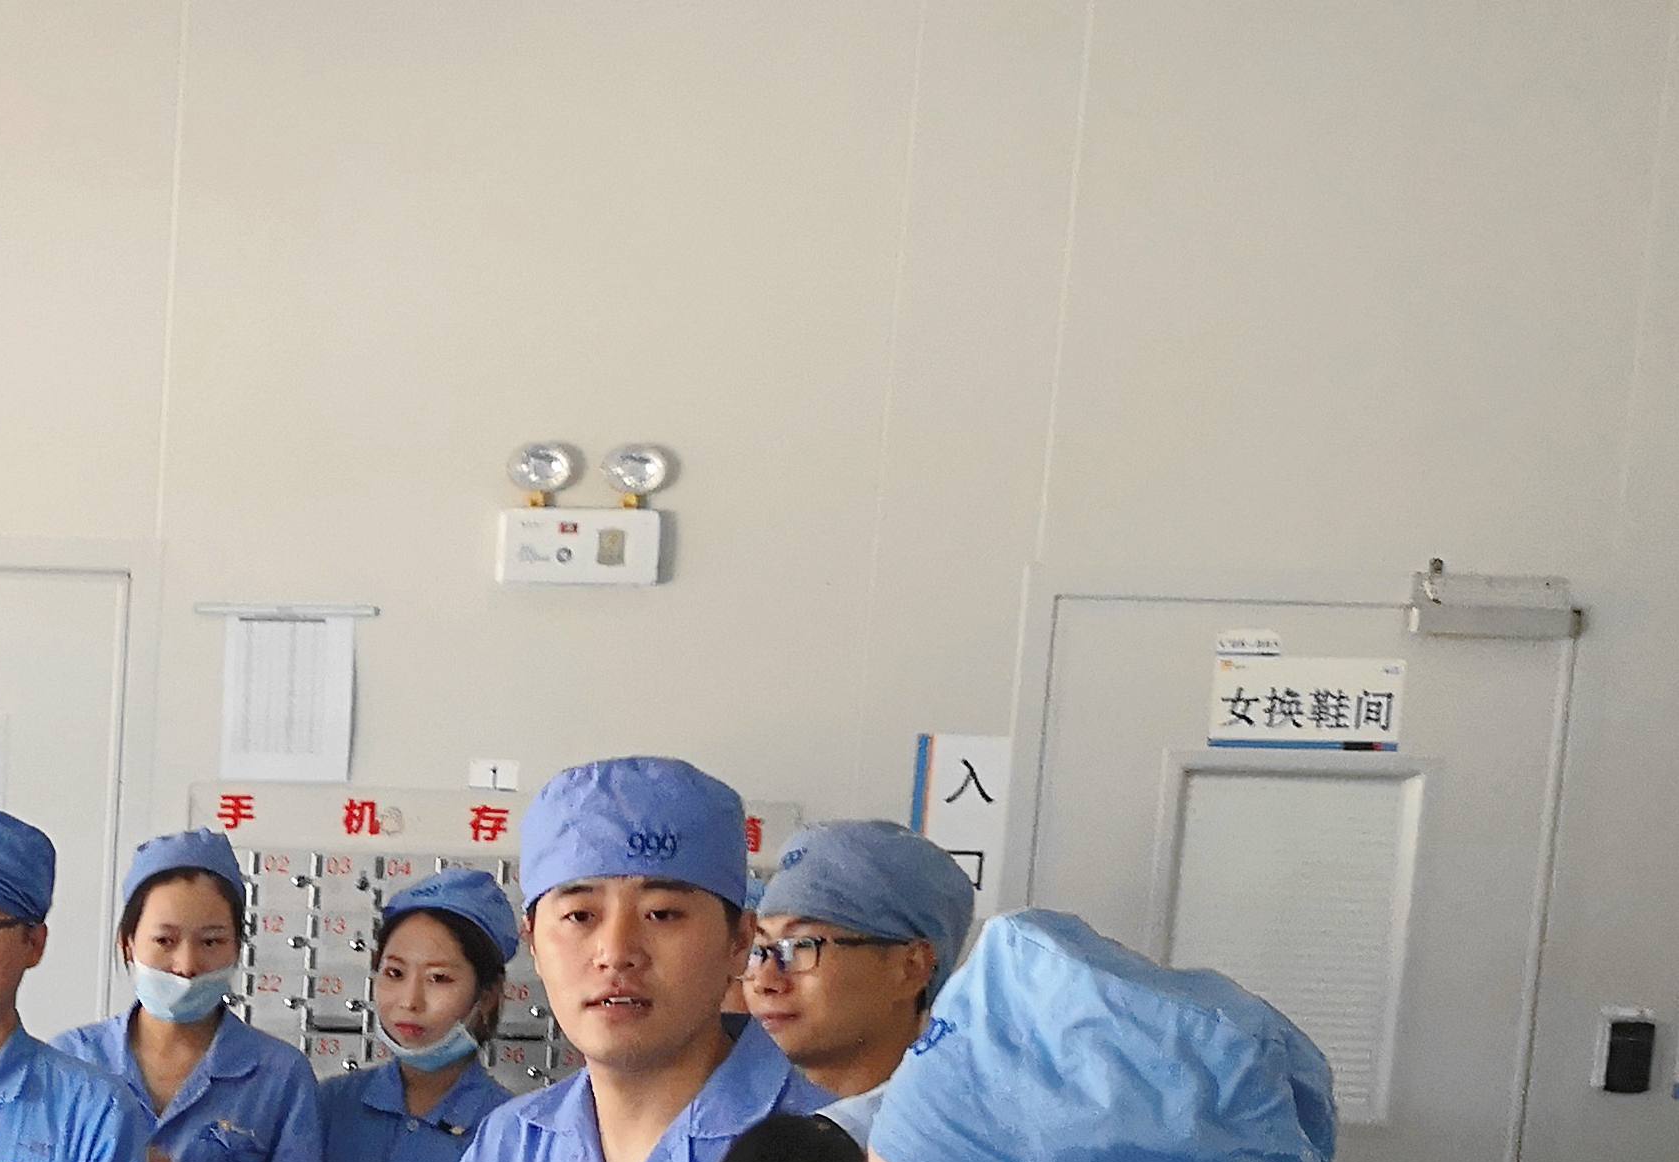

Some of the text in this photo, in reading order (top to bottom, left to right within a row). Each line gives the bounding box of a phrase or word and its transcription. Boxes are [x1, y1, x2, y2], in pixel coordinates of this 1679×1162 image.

[1220, 687, 1394, 731] 女换鞋间
[264, 855, 290, 874] 02
[327, 856, 353, 875] 03
[387, 859, 412, 877] 04
[262, 915, 284, 934] 12
[325, 916, 347, 936] 13
[257, 974, 283, 993] 22
[317, 976, 343, 994] 23
[315, 1038, 342, 1056] 33
